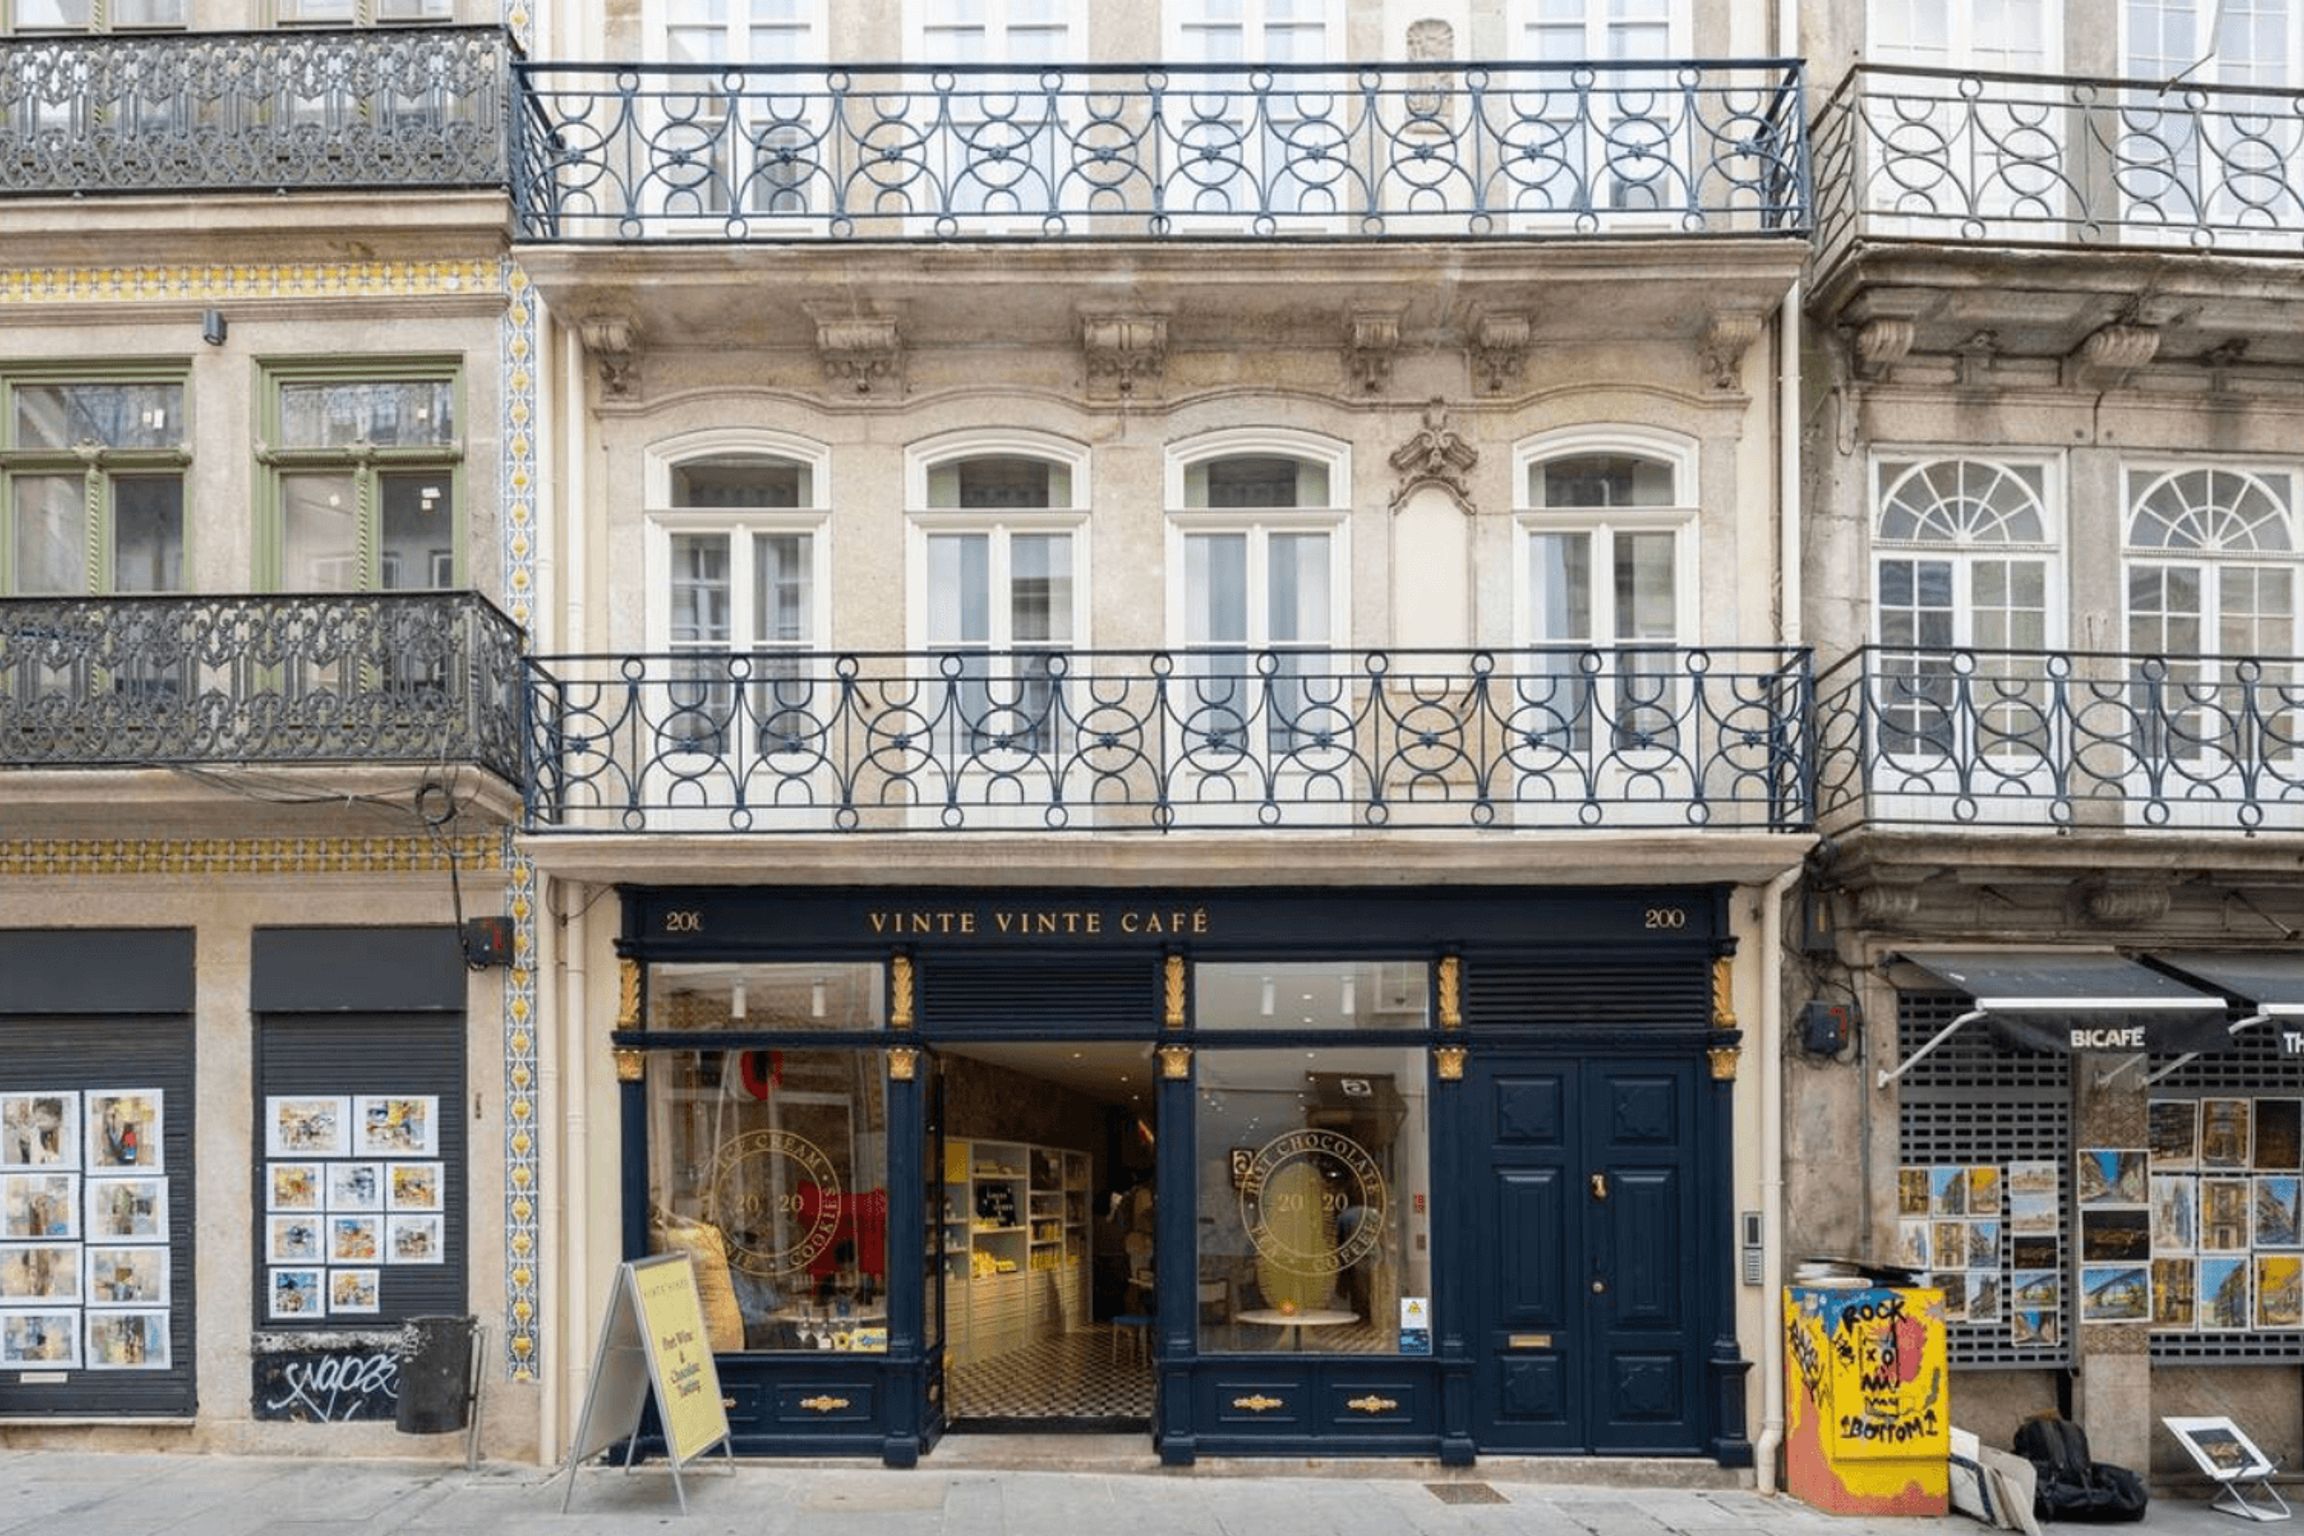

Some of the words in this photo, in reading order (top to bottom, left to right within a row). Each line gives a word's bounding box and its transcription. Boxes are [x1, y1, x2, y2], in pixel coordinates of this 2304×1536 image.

[869, 912, 975, 933] VINTE
[995, 912, 1100, 933] VINTE
[1120, 908, 1208, 933] CAFÉ
[1645, 908, 1685, 929] 200
[2070, 1025, 2146, 1048] BICAFÉ
[755, 1133, 821, 1169] CREAM
[1246, 1154, 1273, 1195] HOT
[1276, 1134, 1381, 1195] CHOCOLATE
[735, 1193, 760, 1213] 20
[779, 1193, 805, 1213] 20
[1277, 1192, 1304, 1213] 20
[1322, 1192, 1349, 1213] 20
[789, 1186, 838, 1266] COOKIES
[1312, 1219, 1379, 1272] COFFEE
[1842, 1298, 1907, 1335] ROCK
[1850, 1416, 1925, 1444] BOTTOM
